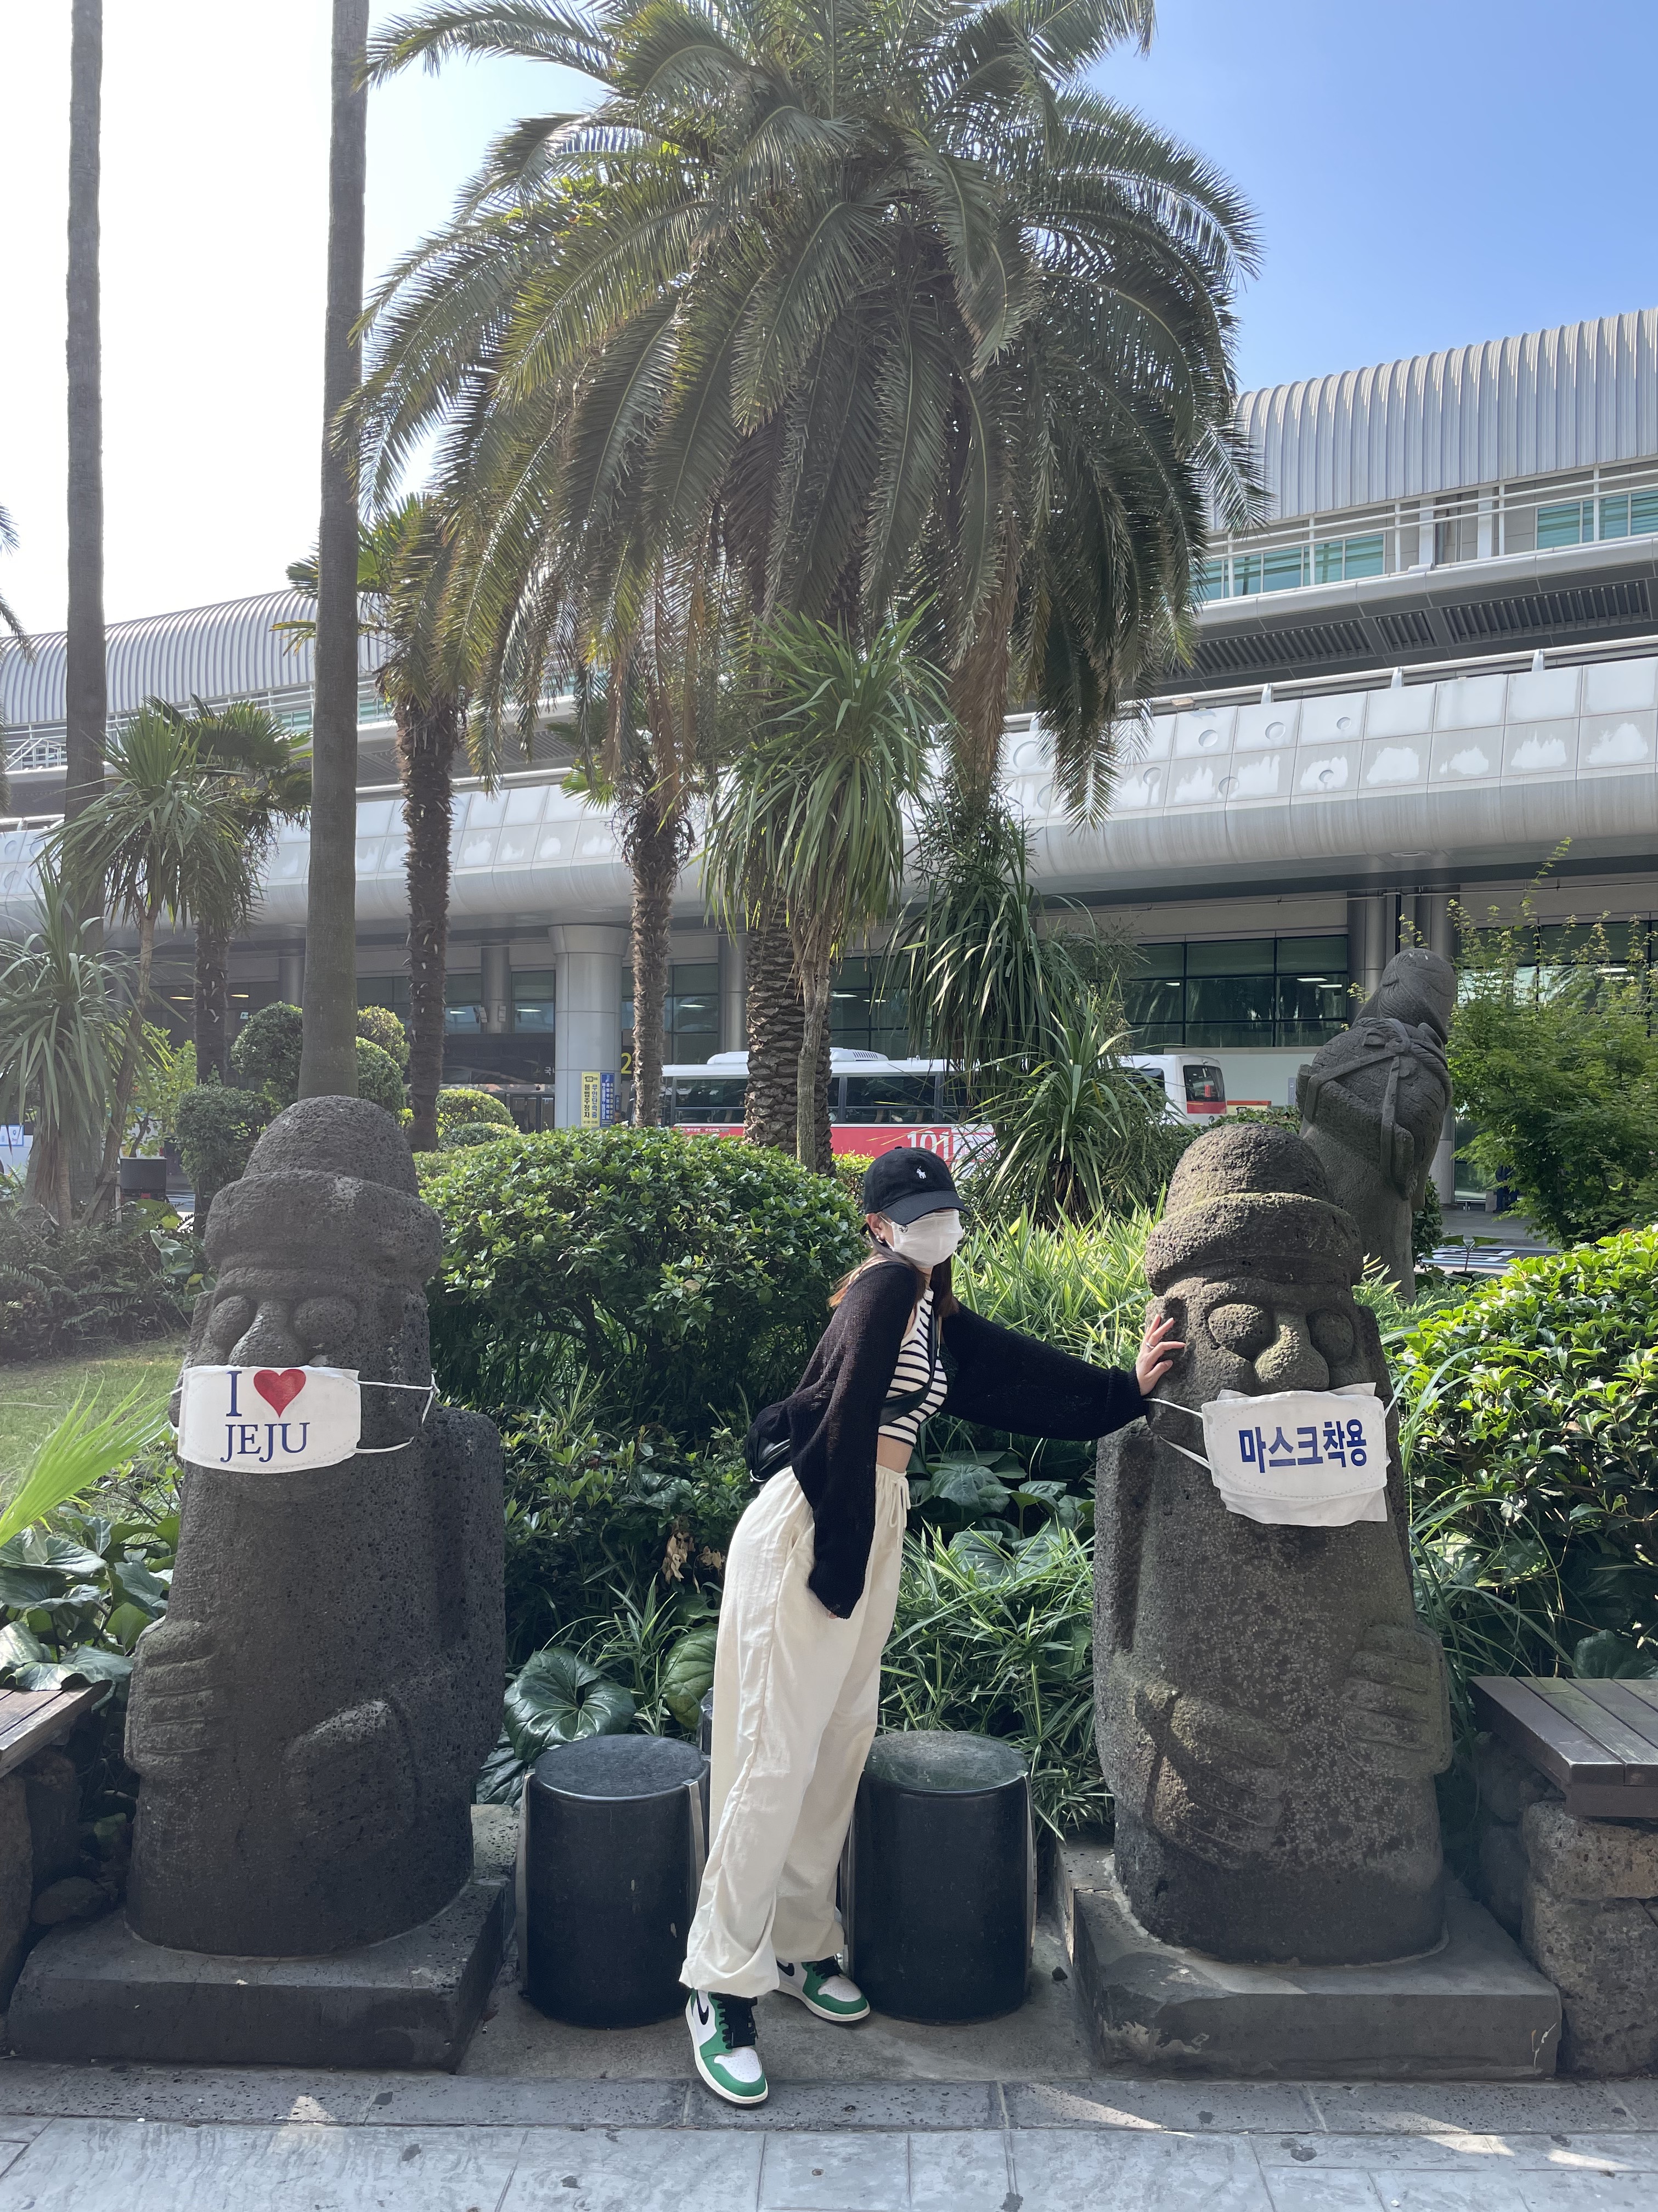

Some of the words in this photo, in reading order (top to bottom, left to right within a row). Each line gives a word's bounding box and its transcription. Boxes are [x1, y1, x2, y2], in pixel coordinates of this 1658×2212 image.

[621, 1052, 631, 1074] 2
[907, 1130, 950, 1161] 101
[225, 1370, 243, 1417] I
[220, 1422, 311, 1463] JEJU
[1238, 1419, 1367, 1474] 마스크착용
